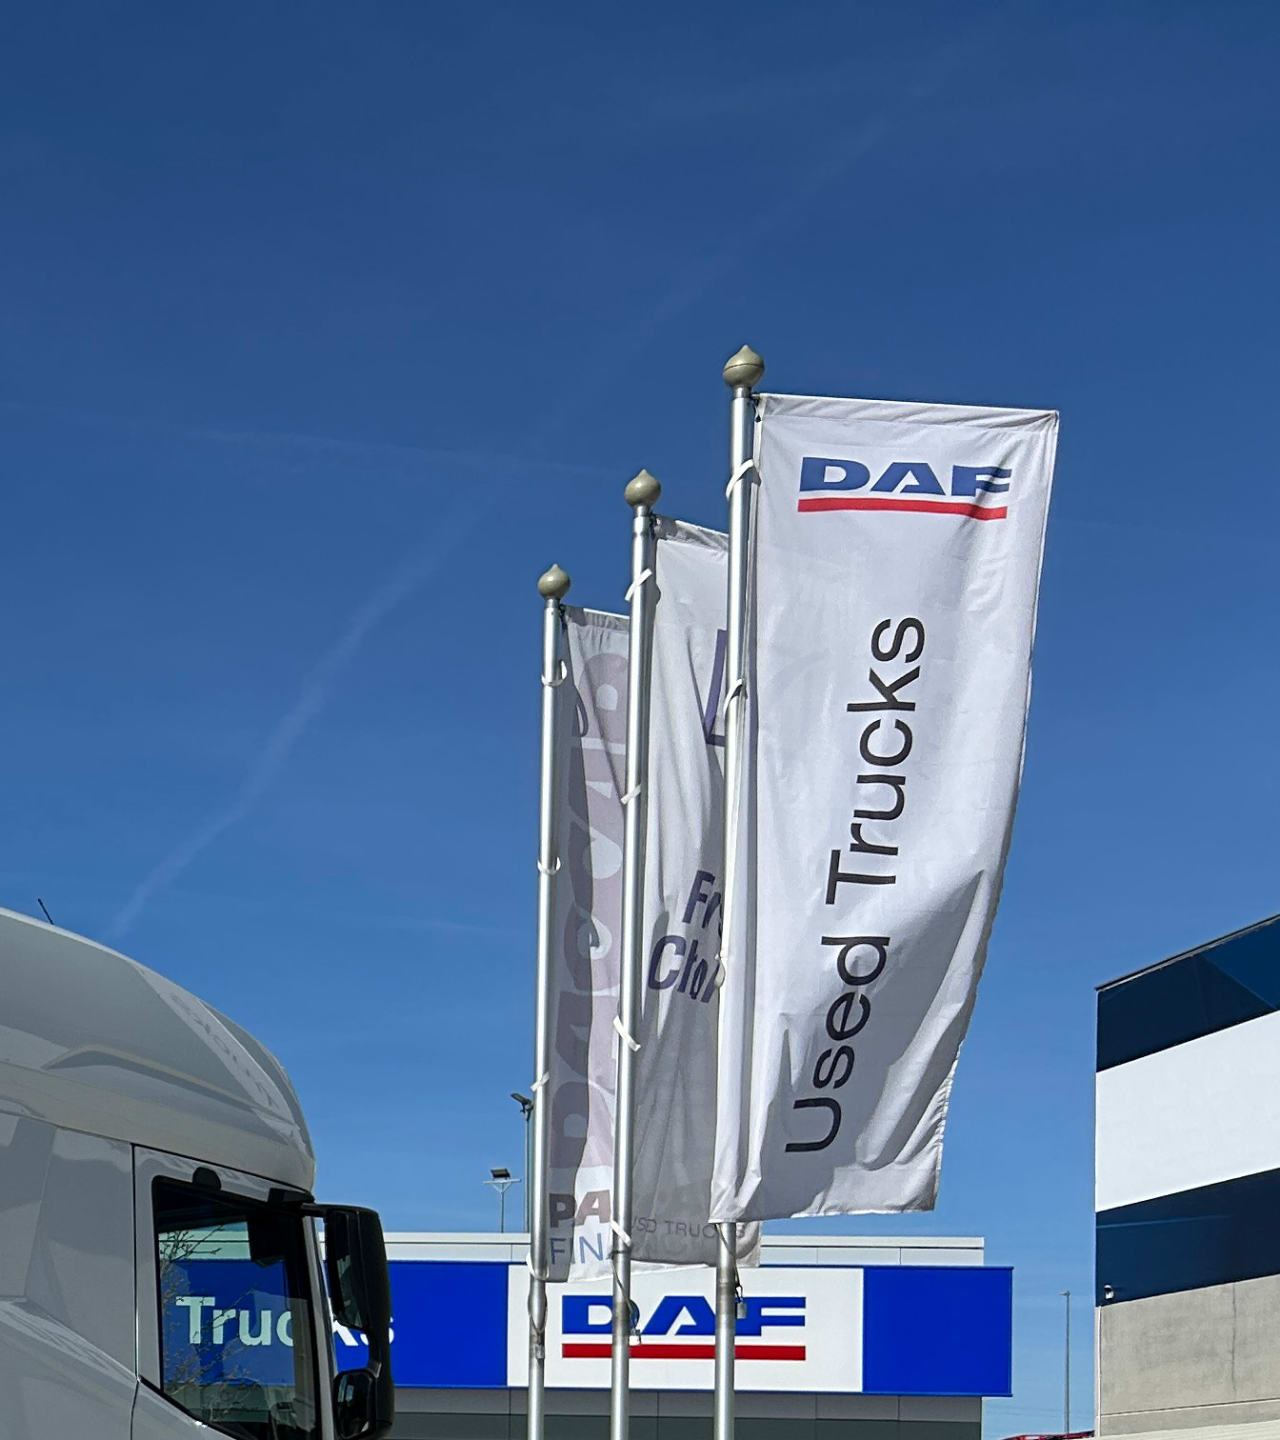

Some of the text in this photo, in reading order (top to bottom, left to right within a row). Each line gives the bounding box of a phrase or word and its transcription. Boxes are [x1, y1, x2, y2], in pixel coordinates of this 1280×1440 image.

[799, 455, 1012, 496] DAF
[785, 615, 927, 1154] Used Trucks
[549, 1189, 611, 1228] PA
[562, 1294, 806, 1337] DAF
